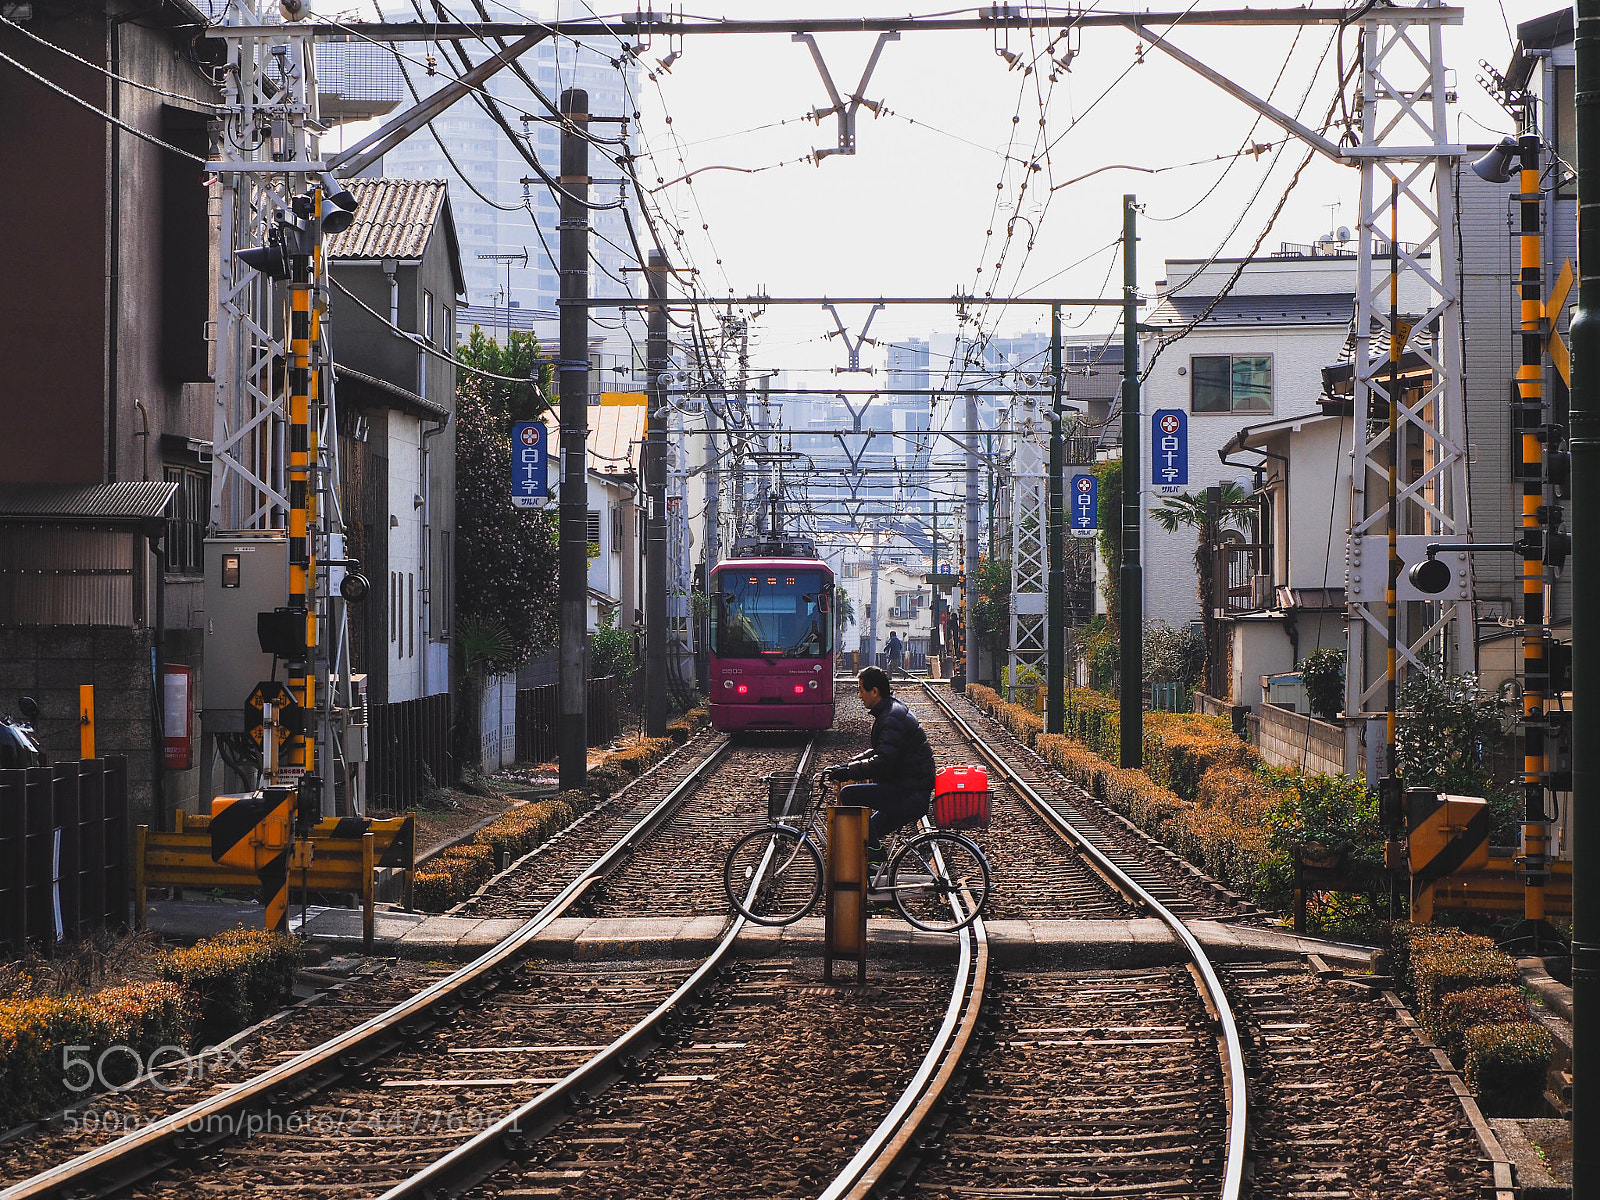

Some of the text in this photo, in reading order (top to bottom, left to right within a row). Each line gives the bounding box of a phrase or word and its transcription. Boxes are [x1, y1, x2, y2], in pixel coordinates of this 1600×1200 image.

[521, 447, 539, 495] 白十字
[1161, 435, 1179, 483] 白十字
[521, 497, 540, 505] サルバ
[1161, 485, 1180, 493] サルバ
[1077, 493, 1091, 528] 白十字
